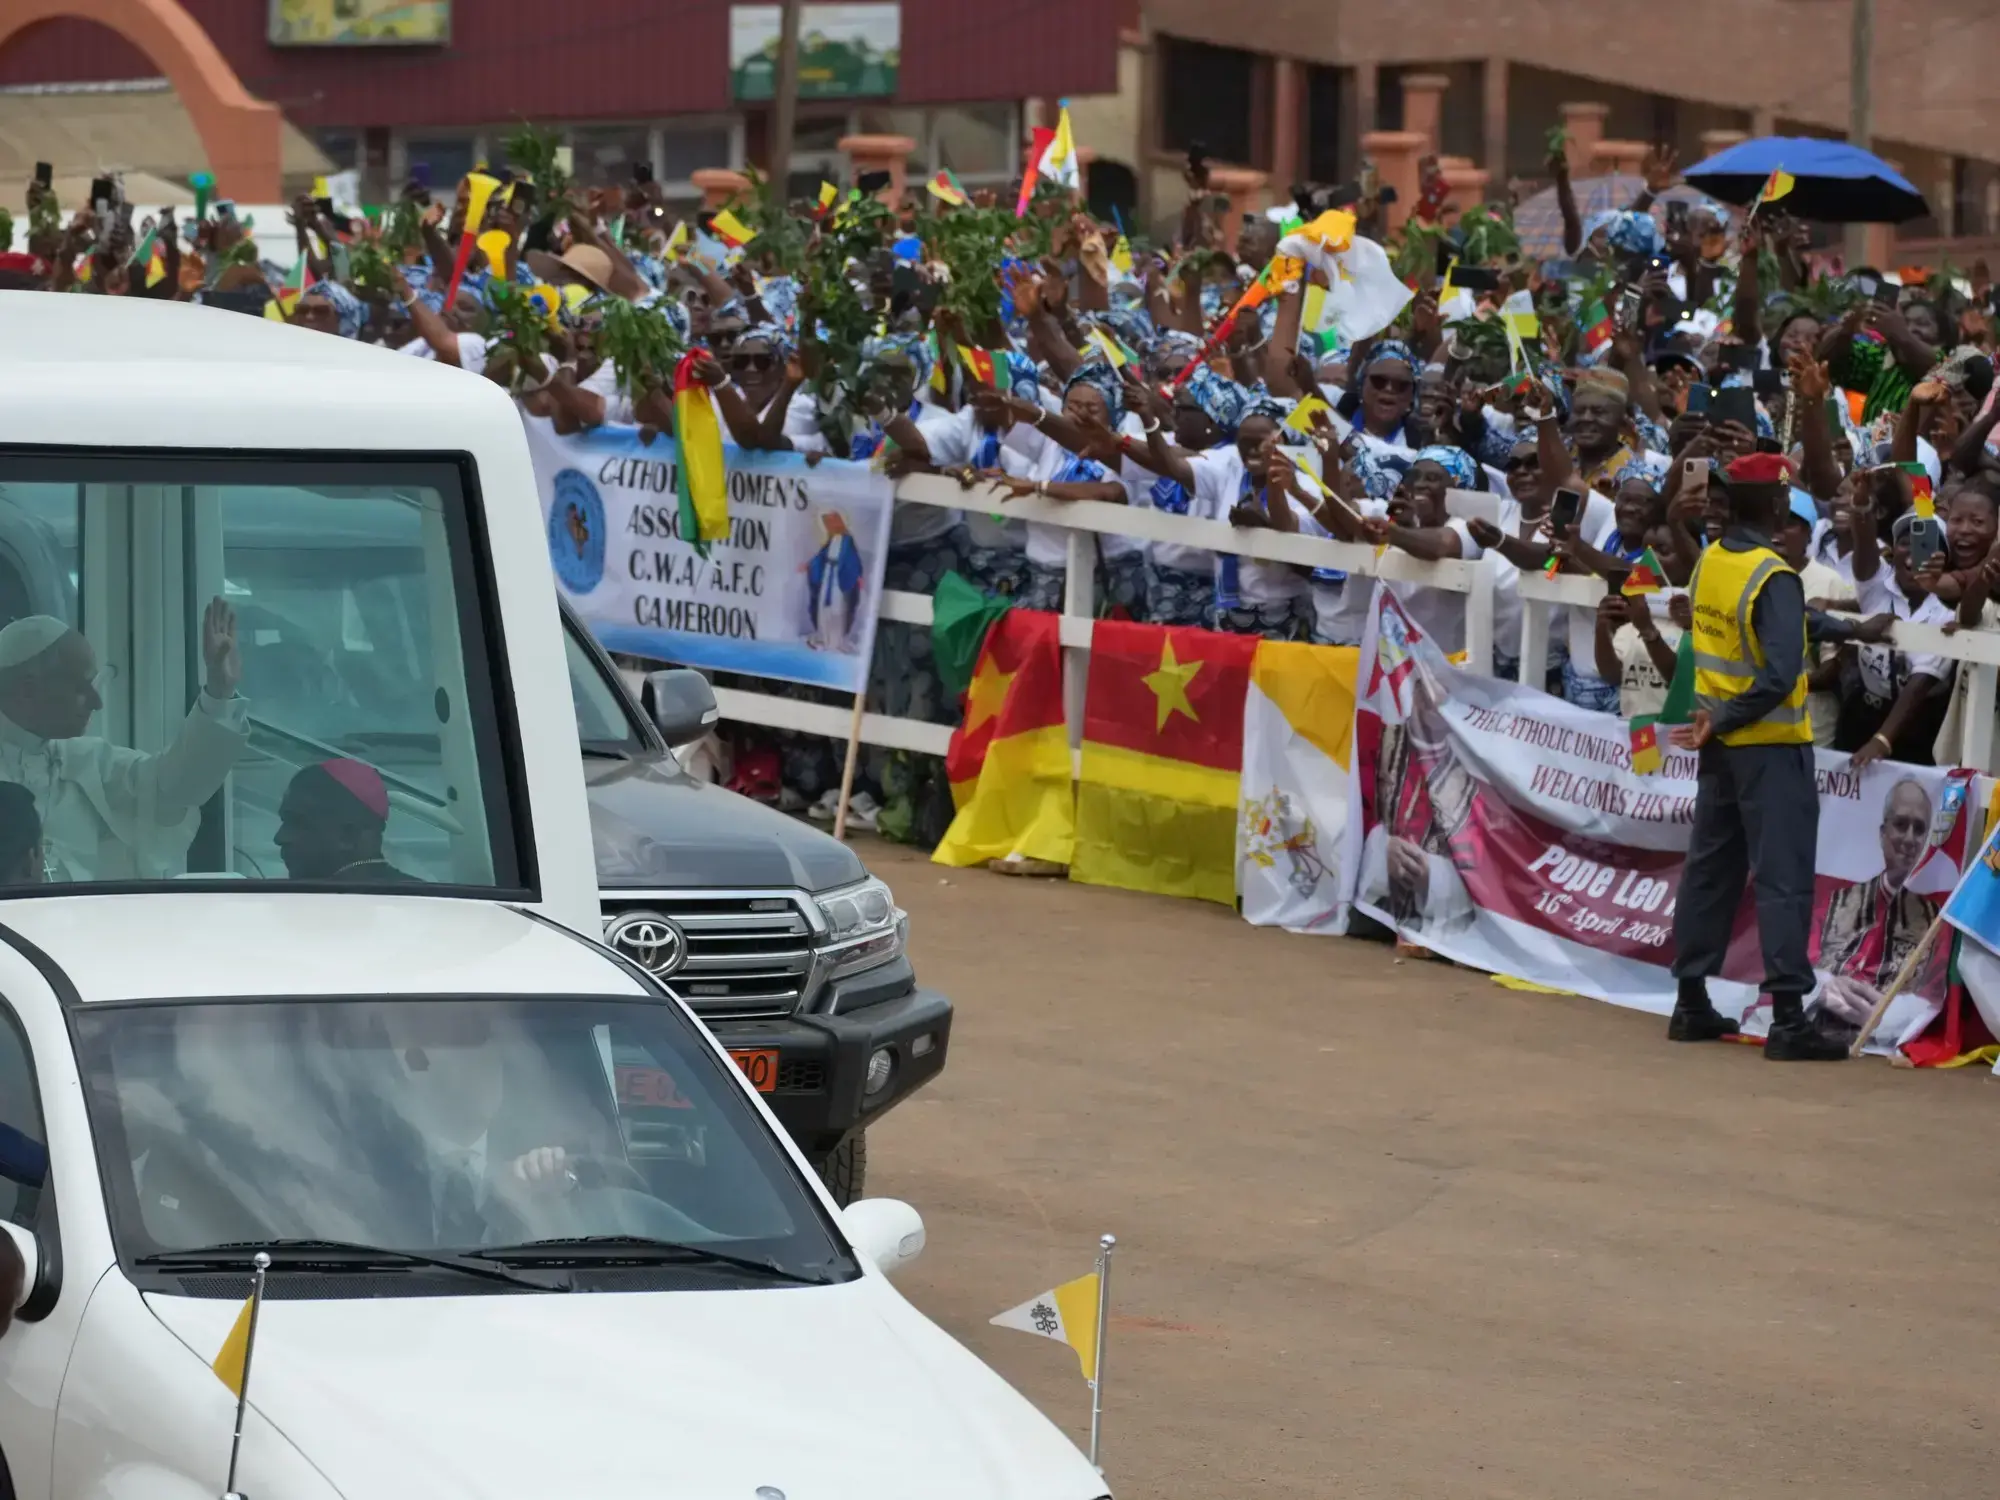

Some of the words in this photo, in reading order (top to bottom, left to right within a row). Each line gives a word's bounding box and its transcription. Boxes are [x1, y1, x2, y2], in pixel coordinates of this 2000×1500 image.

[726, 470, 809, 511] OMEN'S
[633, 594, 758, 641] CAMEROON
[1529, 763, 1633, 817] WELCOMES
[1629, 791, 1668, 823] HIS
[1815, 768, 1861, 801] ENDA
[1527, 843, 1616, 898] Pope
[1611, 869, 1669, 912] Leo
[1567, 906, 1625, 932] April
[1620, 920, 1673, 947] 2026
